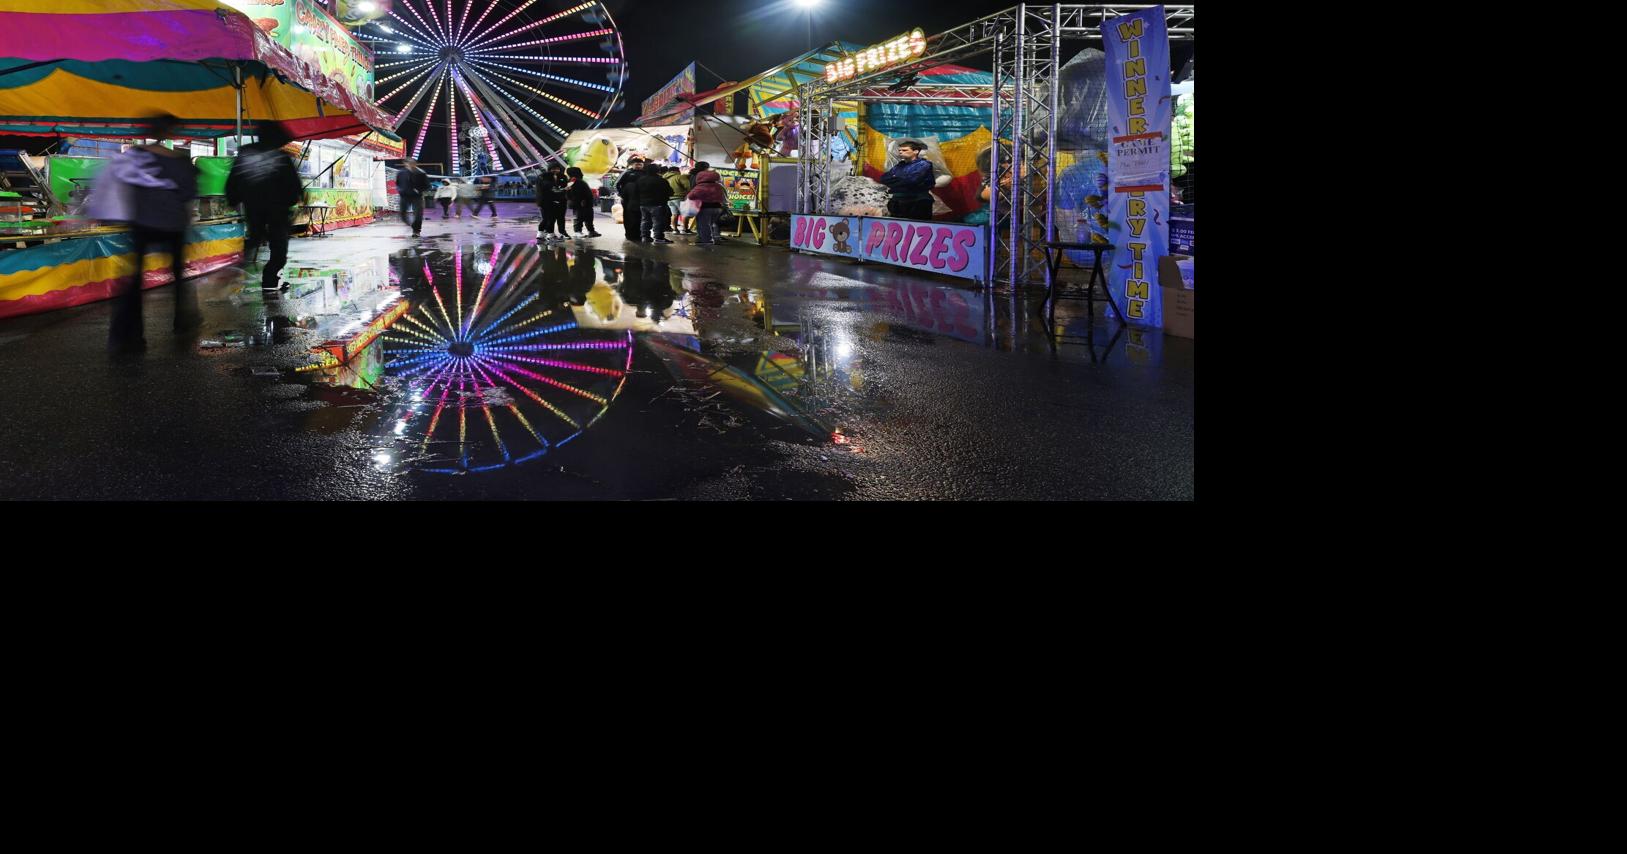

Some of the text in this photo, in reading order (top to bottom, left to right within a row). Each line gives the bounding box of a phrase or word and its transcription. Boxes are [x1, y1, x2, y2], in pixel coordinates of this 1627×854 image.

[825, 28, 926, 83] BIG PRIZES
[1117, 18, 1147, 135] WINNER
[1117, 145, 1160, 156] PERMIT
[793, 216, 976, 272] BIG PRIZES
[1126, 242, 1149, 318] TIME
